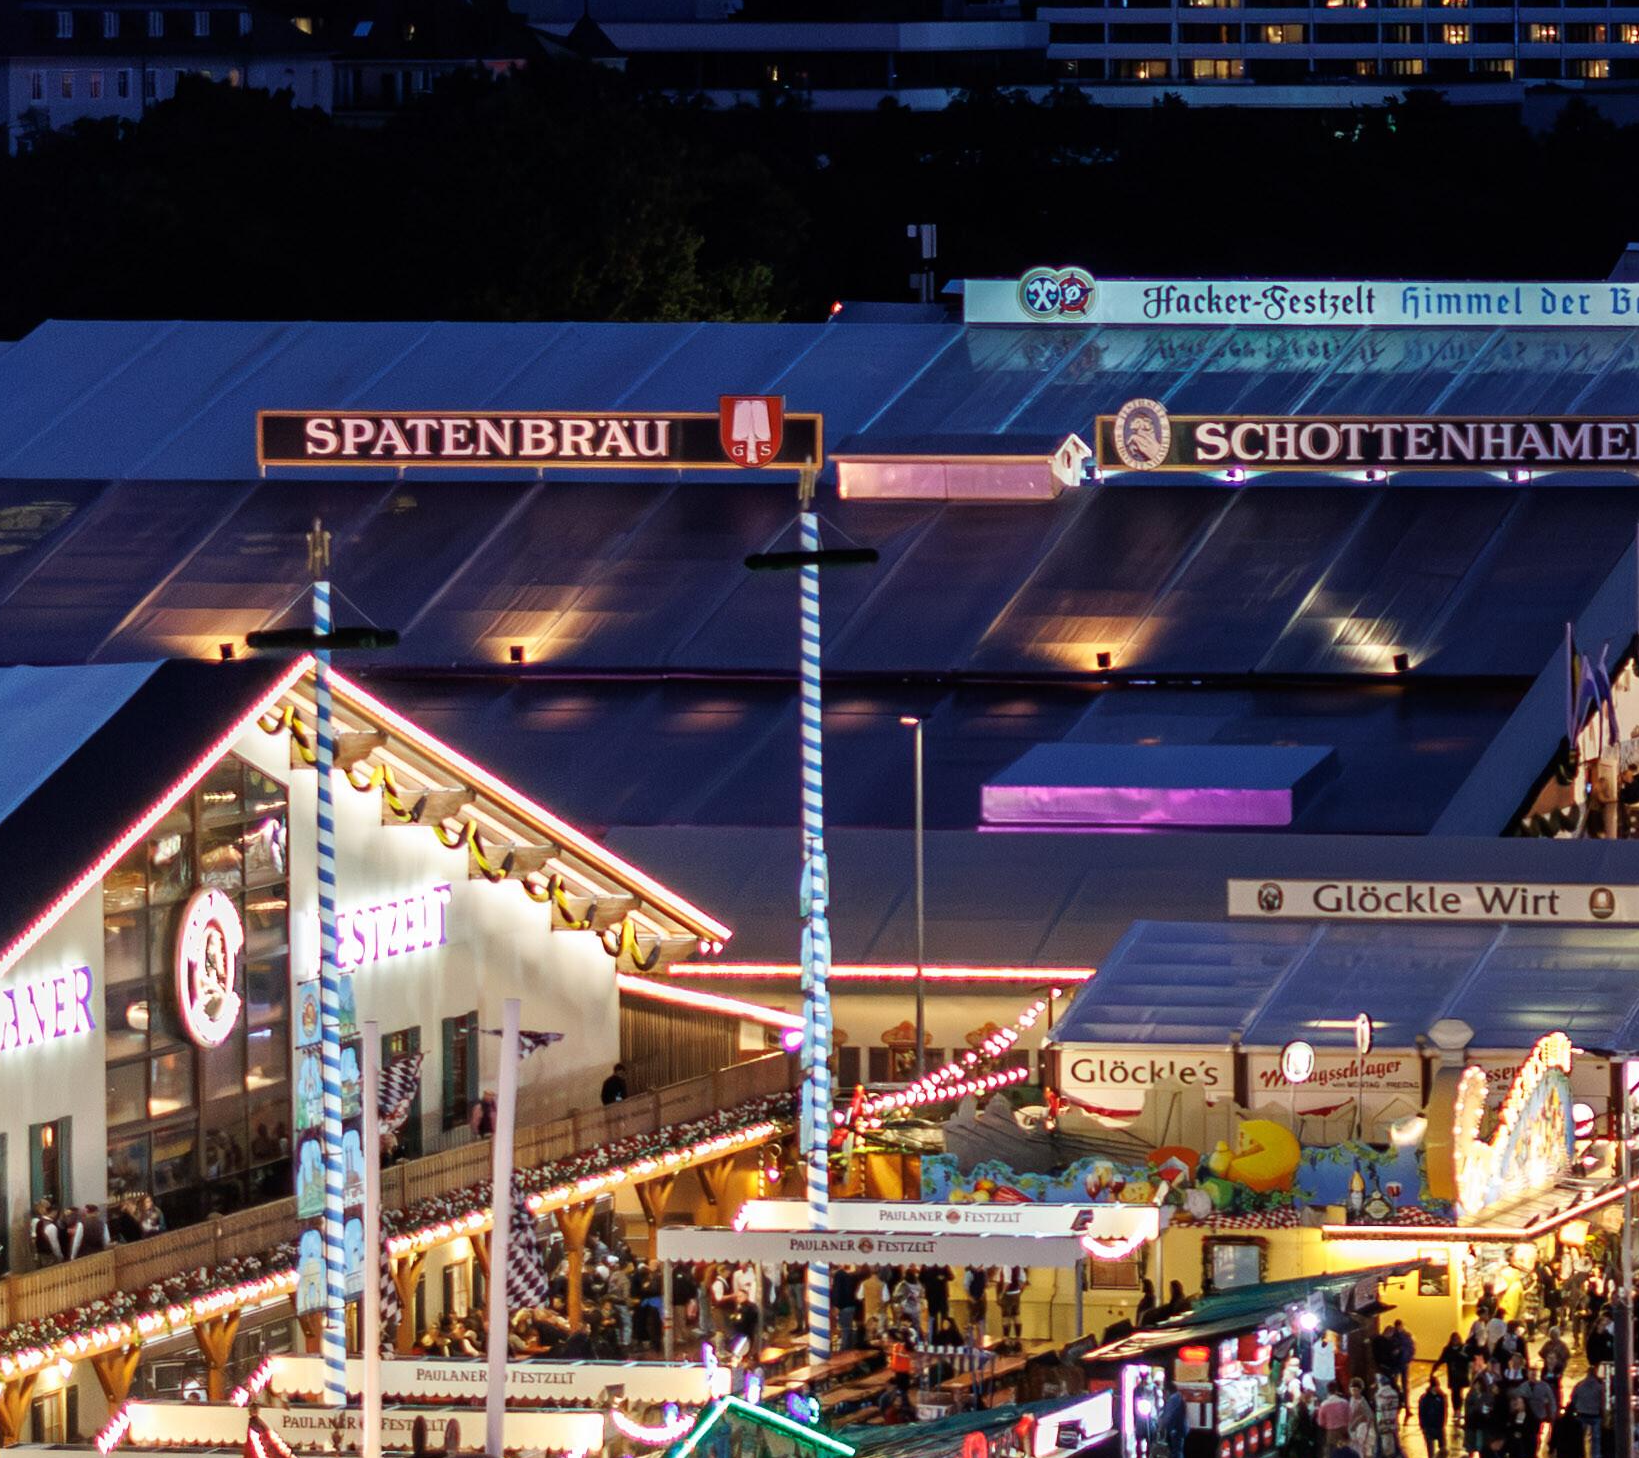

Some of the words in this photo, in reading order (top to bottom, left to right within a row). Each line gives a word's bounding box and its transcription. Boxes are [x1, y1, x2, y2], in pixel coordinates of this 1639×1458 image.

[1143, 285, 1376, 320] Hacker-Festzelt
[1401, 288, 1523, 320] Himmel
[1540, 288, 1591, 317] der
[304, 417, 670, 459] SPATENBRÄU
[1312, 884, 1462, 916] Glöckle
[1475, 886, 1560, 915] Wirt
[879, 1210, 944, 1224] PAULANER
[964, 1212, 1021, 1224] FESTZELT
[790, 1239, 856, 1253] PAULANER
[877, 1240, 936, 1254] FESTZELT
[416, 1368, 487, 1384] PAULANER
[511, 1370, 574, 1385] FESTZELT
[282, 1414, 358, 1430] PAULANER
